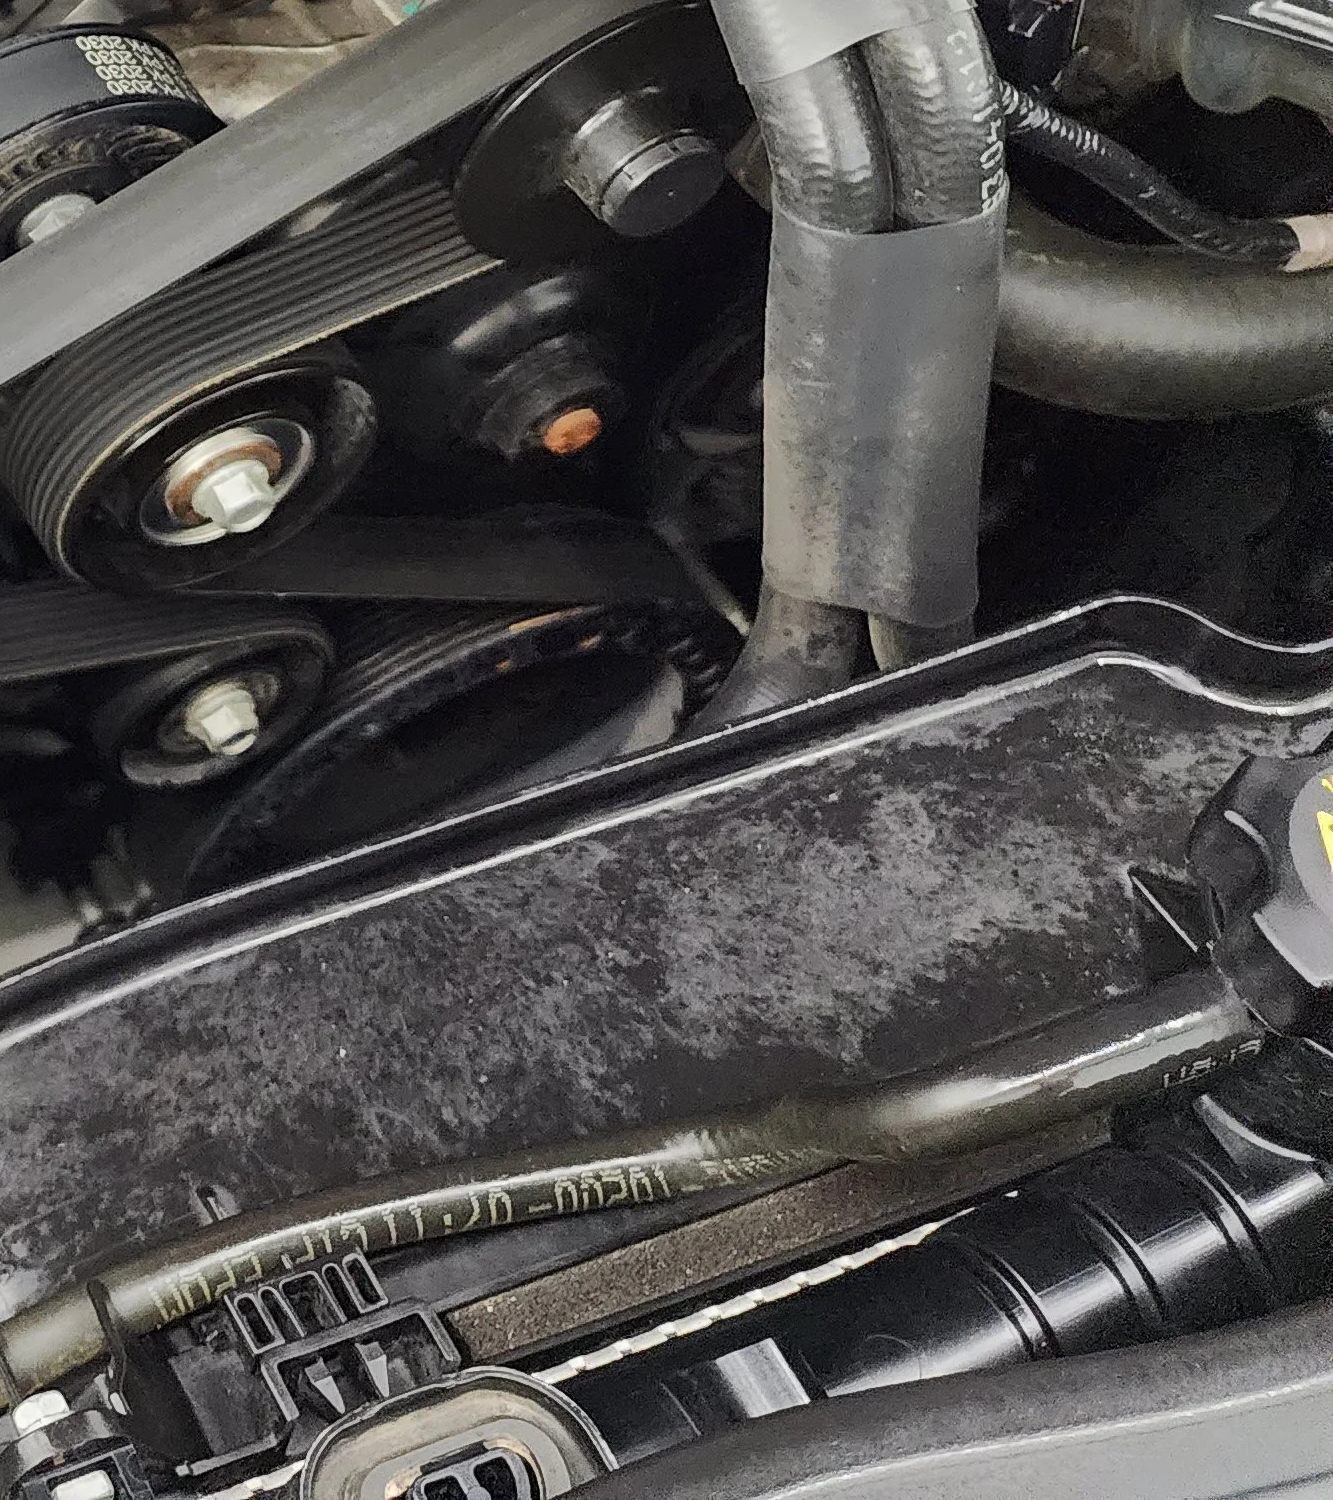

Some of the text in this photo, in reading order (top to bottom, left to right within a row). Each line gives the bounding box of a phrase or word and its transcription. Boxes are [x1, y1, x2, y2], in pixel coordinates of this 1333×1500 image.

[76, 35, 127, 51] 2030
[85, 50, 137, 66] 2030
[95, 64, 147, 81] 2030
[106, 79, 159, 96] 2030
